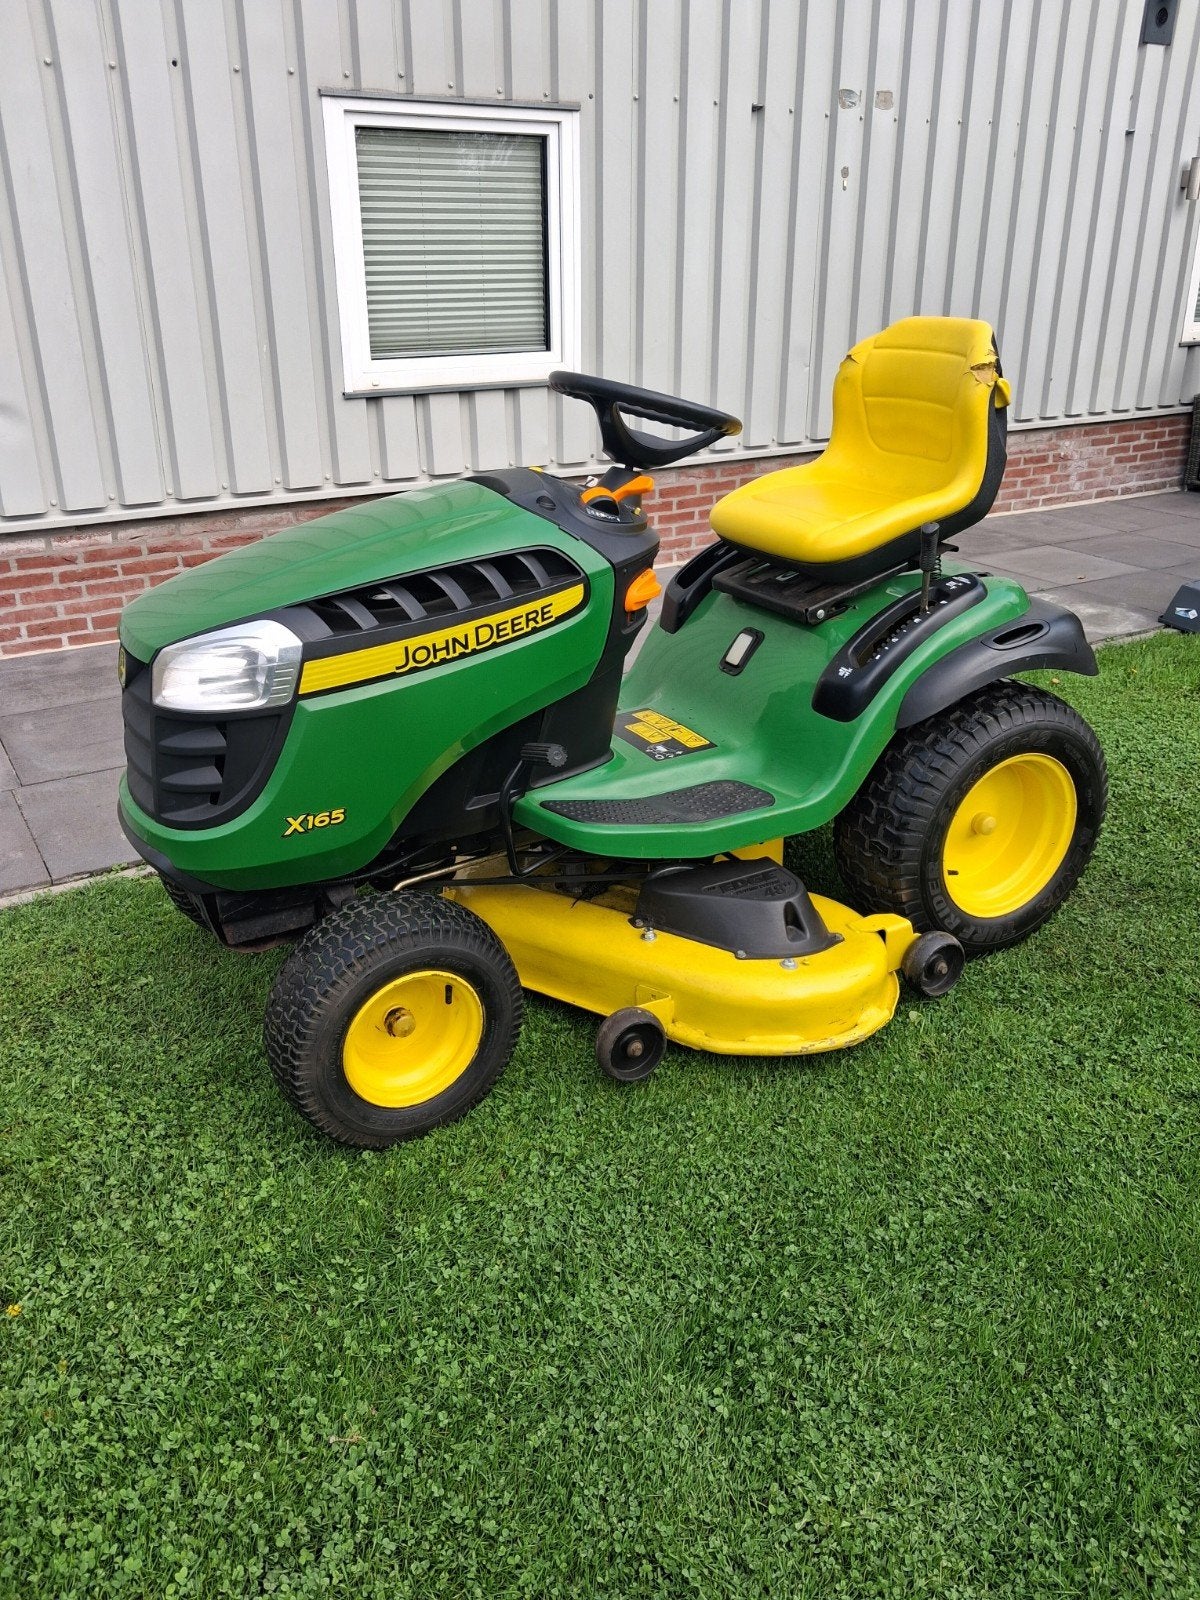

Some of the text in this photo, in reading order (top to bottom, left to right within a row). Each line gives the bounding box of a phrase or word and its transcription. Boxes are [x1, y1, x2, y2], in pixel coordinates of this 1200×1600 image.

[395, 602, 555, 671] JOHN DEERE
[282, 808, 346, 836] X165
[928, 861, 961, 933] RIDER
